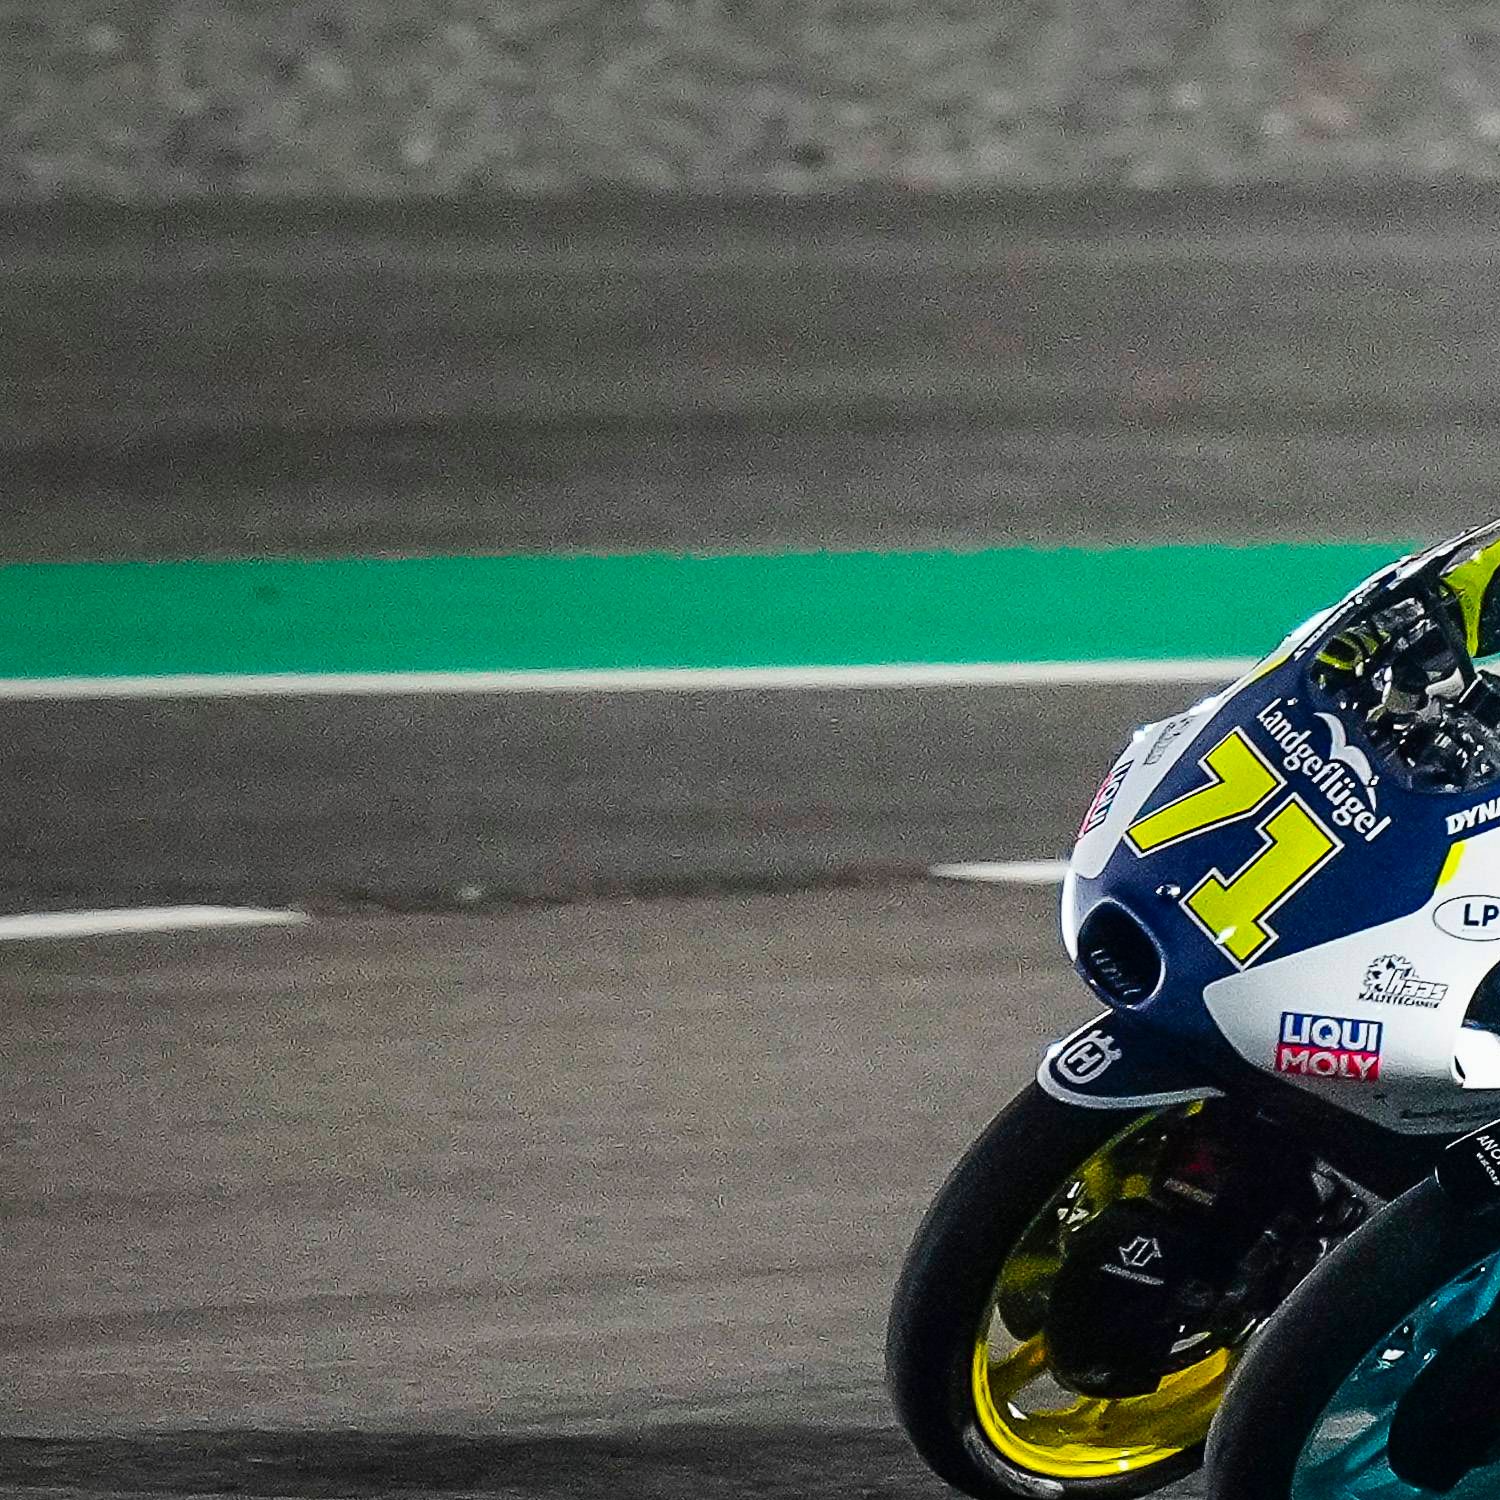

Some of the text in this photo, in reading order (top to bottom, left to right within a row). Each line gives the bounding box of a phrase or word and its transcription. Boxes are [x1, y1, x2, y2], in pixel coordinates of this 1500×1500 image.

[1123, 726, 1345, 971] 71
[1464, 903, 1500, 927] LP
[1283, 1014, 1379, 1051] LIQUI
[1281, 1047, 1378, 1081] MOLY
